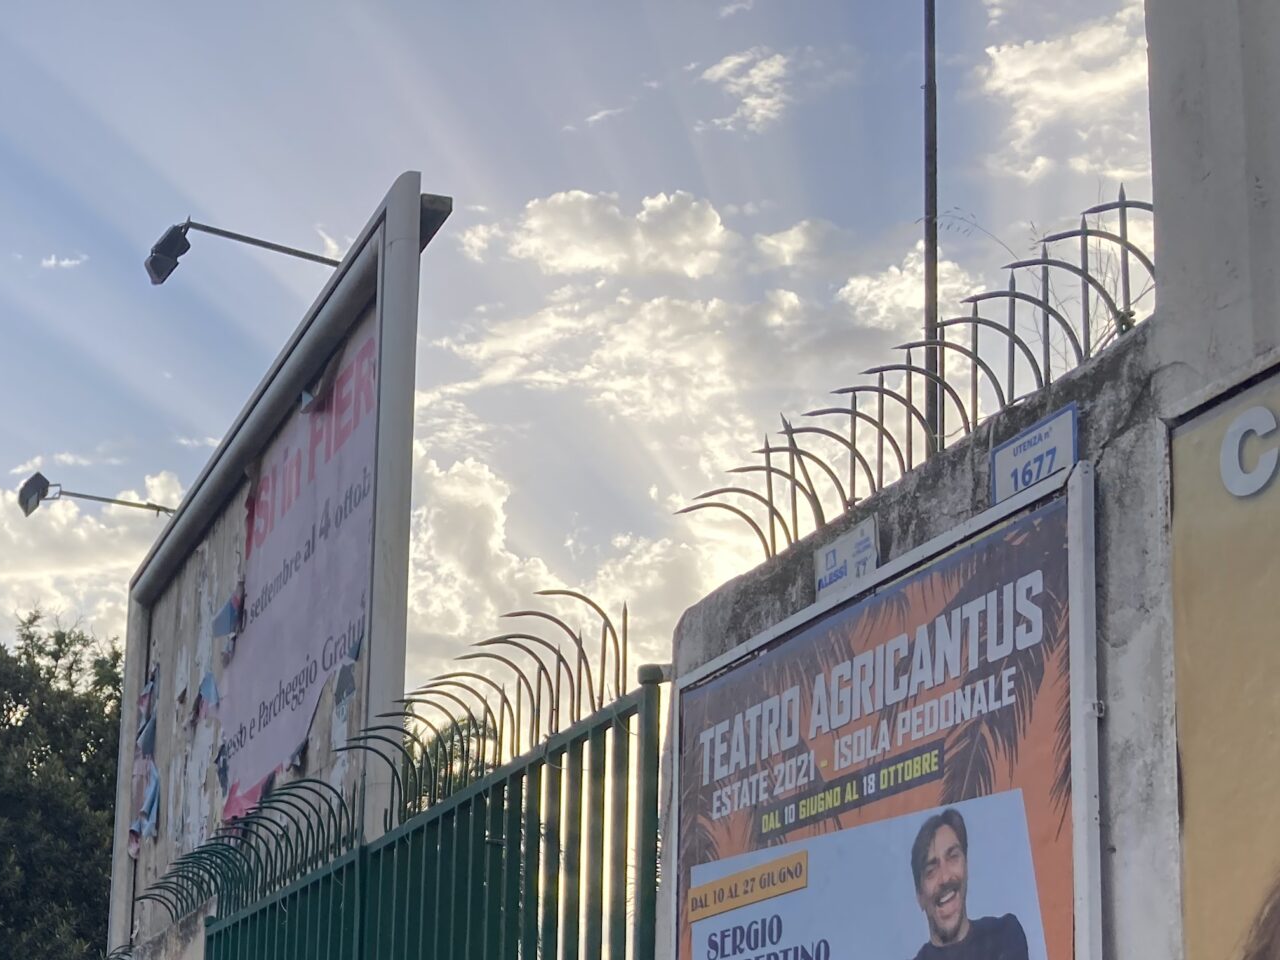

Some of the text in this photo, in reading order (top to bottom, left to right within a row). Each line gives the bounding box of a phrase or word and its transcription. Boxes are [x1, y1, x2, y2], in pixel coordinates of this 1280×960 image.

[1010, 446, 1057, 492] 1677
[1013, 431, 1043, 457] UTENZA
[250, 550, 301, 625] settembre
[303, 523, 316, 563] al
[319, 496, 332, 541] 4
[258, 653, 318, 733] Parcheggio
[698, 569, 1044, 787] TEATRO AGRICANTUS
[712, 767, 770, 821] ESTATE
[773, 750, 816, 796] 2021
[833, 724, 891, 772] ISOLA
[896, 665, 1017, 743] PEDONALE
[761, 749, 940, 834] DAL 10 GIUGNO AL 18 OTTOBRE
[690, 861, 804, 913] DAL 10 AL 27 GIUGNO
